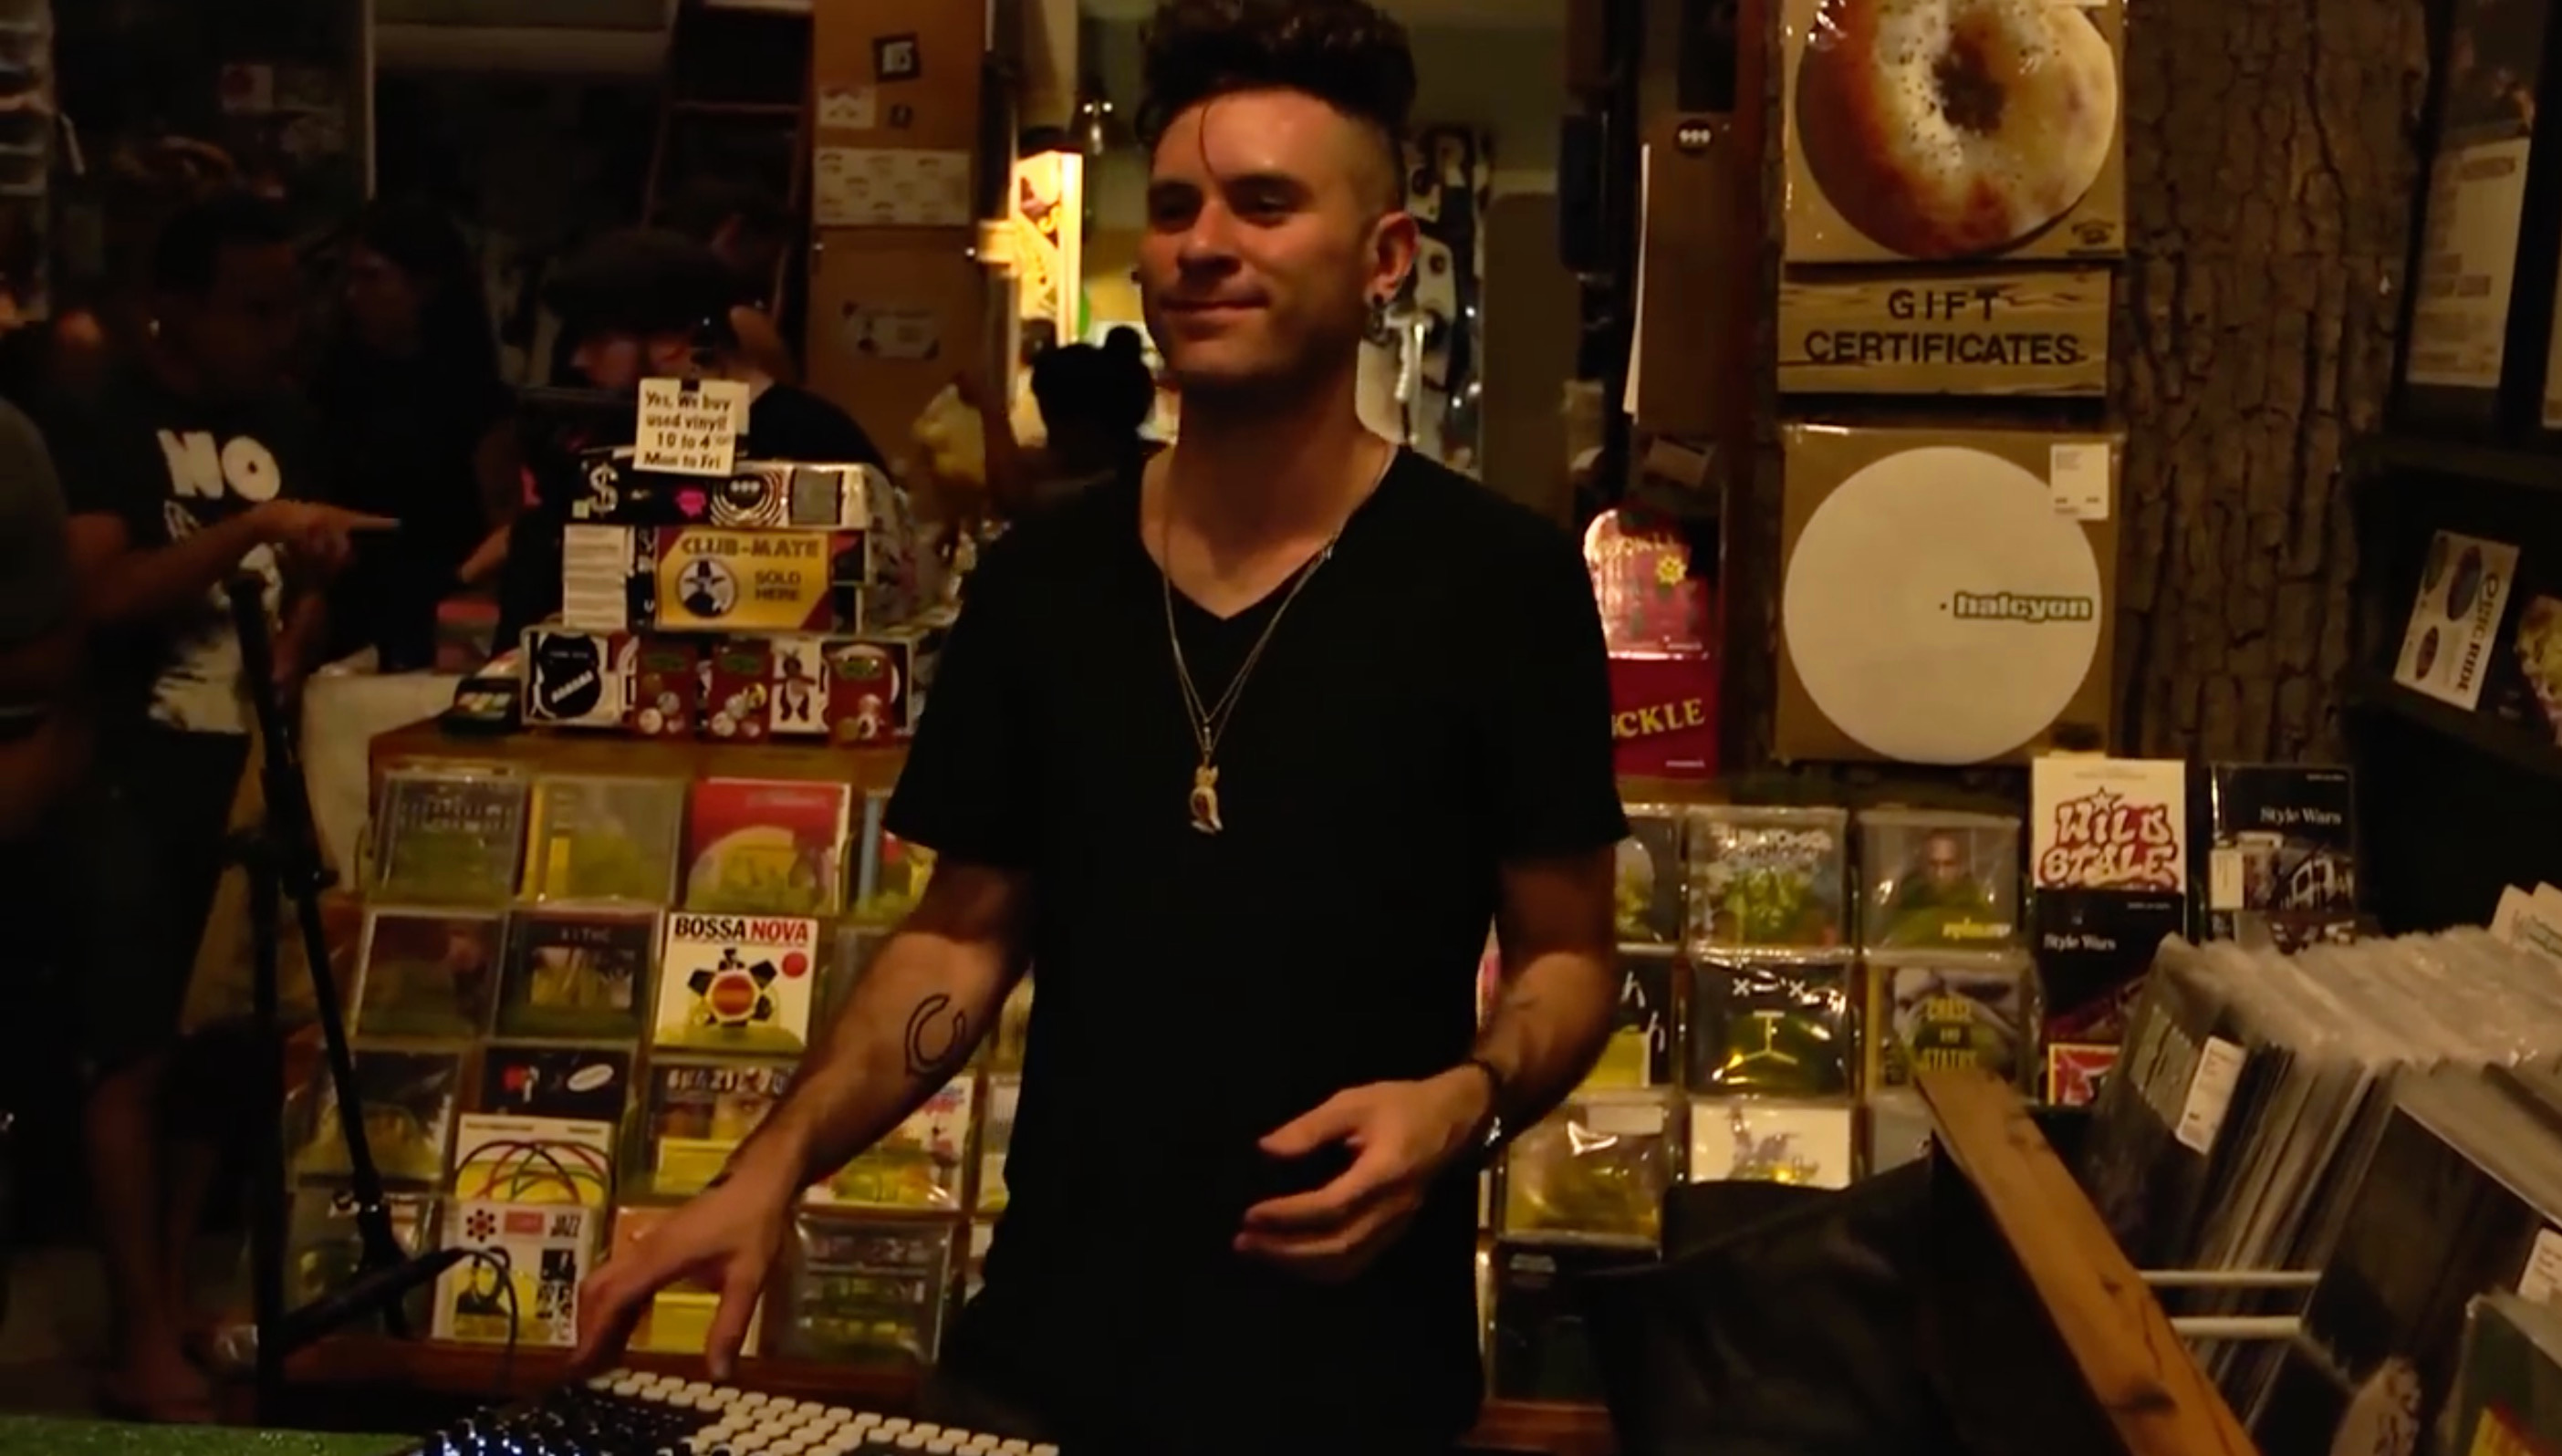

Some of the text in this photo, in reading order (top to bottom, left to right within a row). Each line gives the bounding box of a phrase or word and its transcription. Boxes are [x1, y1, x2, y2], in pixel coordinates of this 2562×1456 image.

[1888, 288, 2000, 321] GIFT
[1804, 330, 2080, 365] CERTIFICATES
[703, 393, 730, 411] buy
[646, 414, 681, 428] used
[658, 432, 676, 447] 10
[682, 435, 696, 449] to
[700, 435, 711, 450] 4
[156, 427, 282, 502] NO
[644, 452, 722, 469] Mon to Fri
[681, 537, 820, 559] CLUB-MATE
[755, 569, 801, 586] SOLD
[755, 587, 798, 602] HERE
[1953, 591, 2092, 623] halcyon
[2057, 792, 2173, 846] WILD
[2260, 806, 2343, 827] Style Wars
[675, 918, 808, 941] BOSSA NOVA
[2043, 932, 2117, 952] Style Wars
